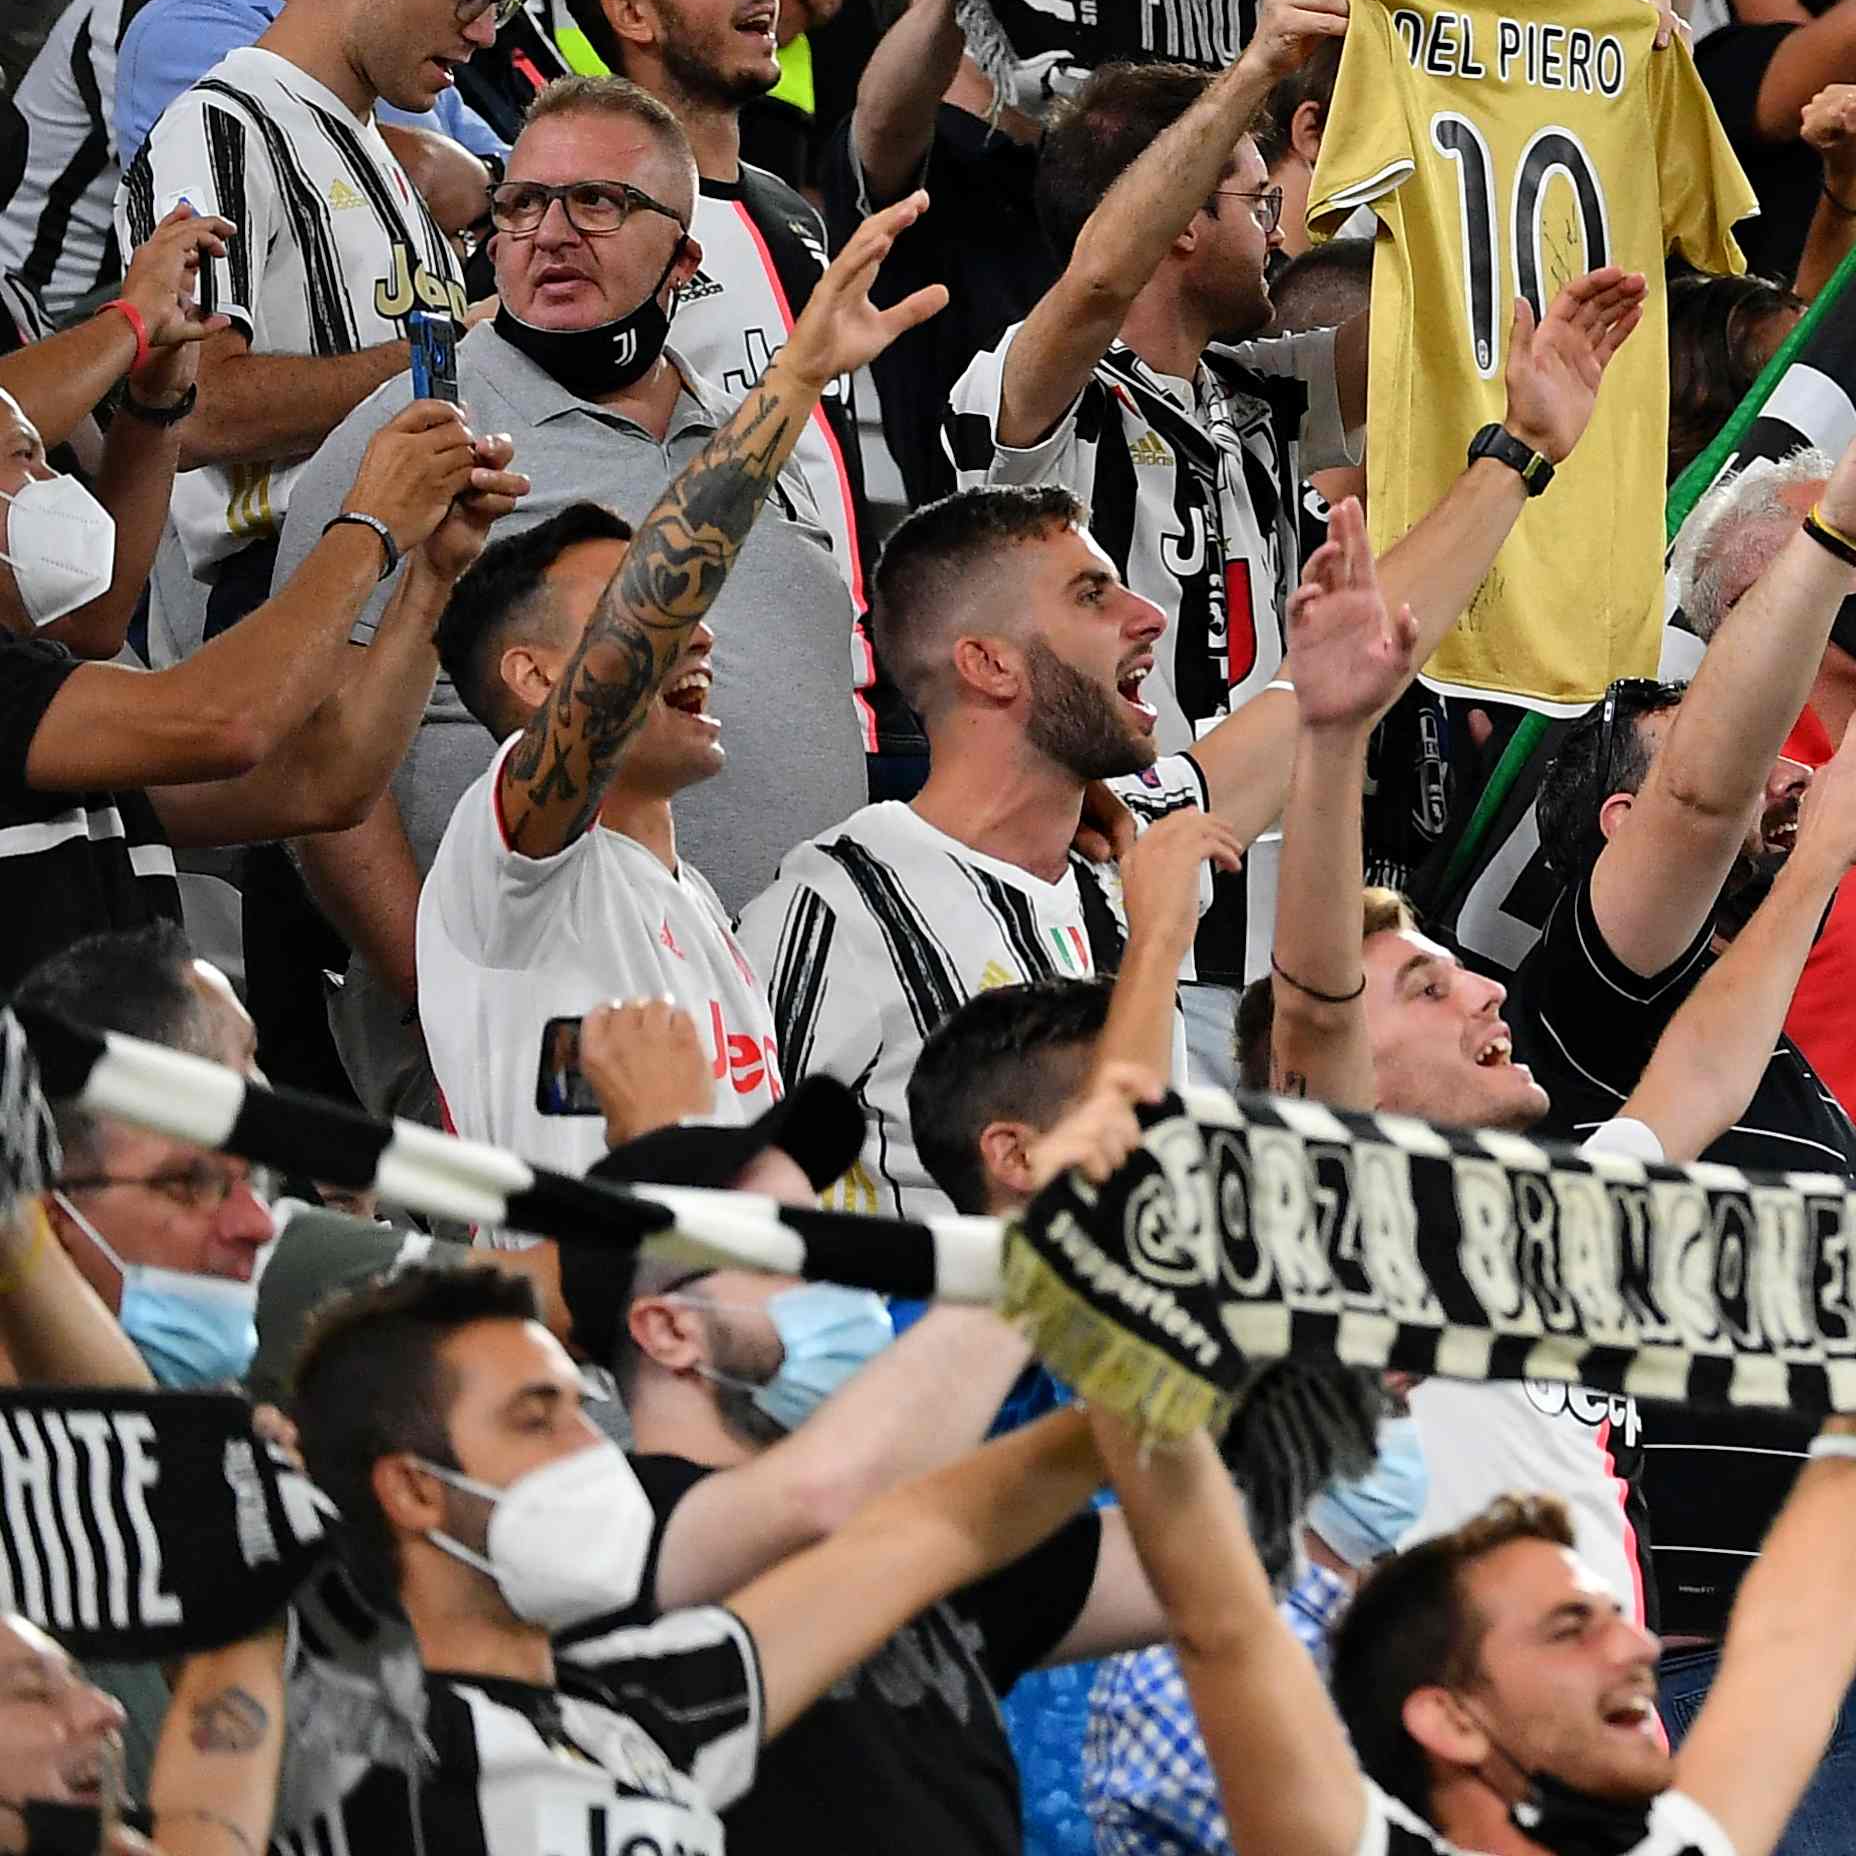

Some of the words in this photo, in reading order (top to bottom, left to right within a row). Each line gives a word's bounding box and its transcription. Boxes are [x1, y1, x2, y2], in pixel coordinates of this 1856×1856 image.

[1392, 8, 1484, 81] DEL
[1497, 14, 1628, 99] PIERO
[1429, 110, 1616, 382] 10
[0, 1408, 184, 1631] HITE
